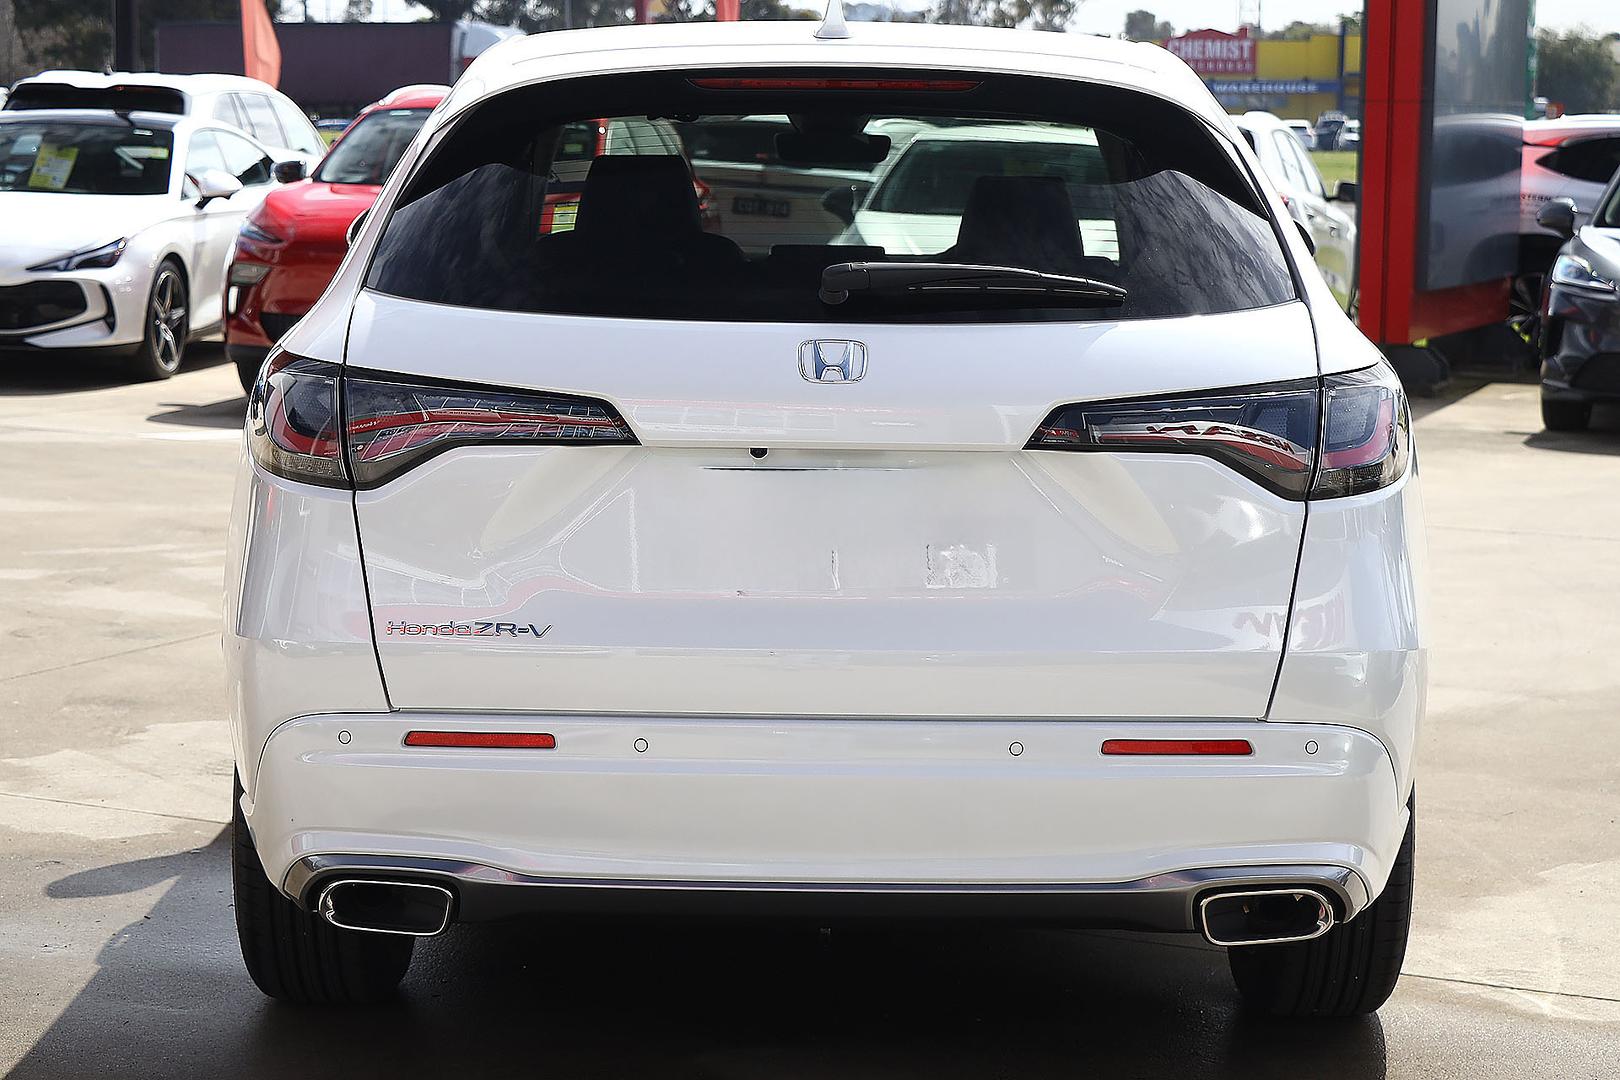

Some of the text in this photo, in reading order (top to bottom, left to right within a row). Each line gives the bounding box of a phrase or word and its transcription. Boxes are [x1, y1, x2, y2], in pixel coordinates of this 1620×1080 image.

[1168, 38, 1252, 60] CHEMIST
[1213, 81, 1319, 93] WAREHOUSE
[385, 619, 553, 639] Honda ZR-V
